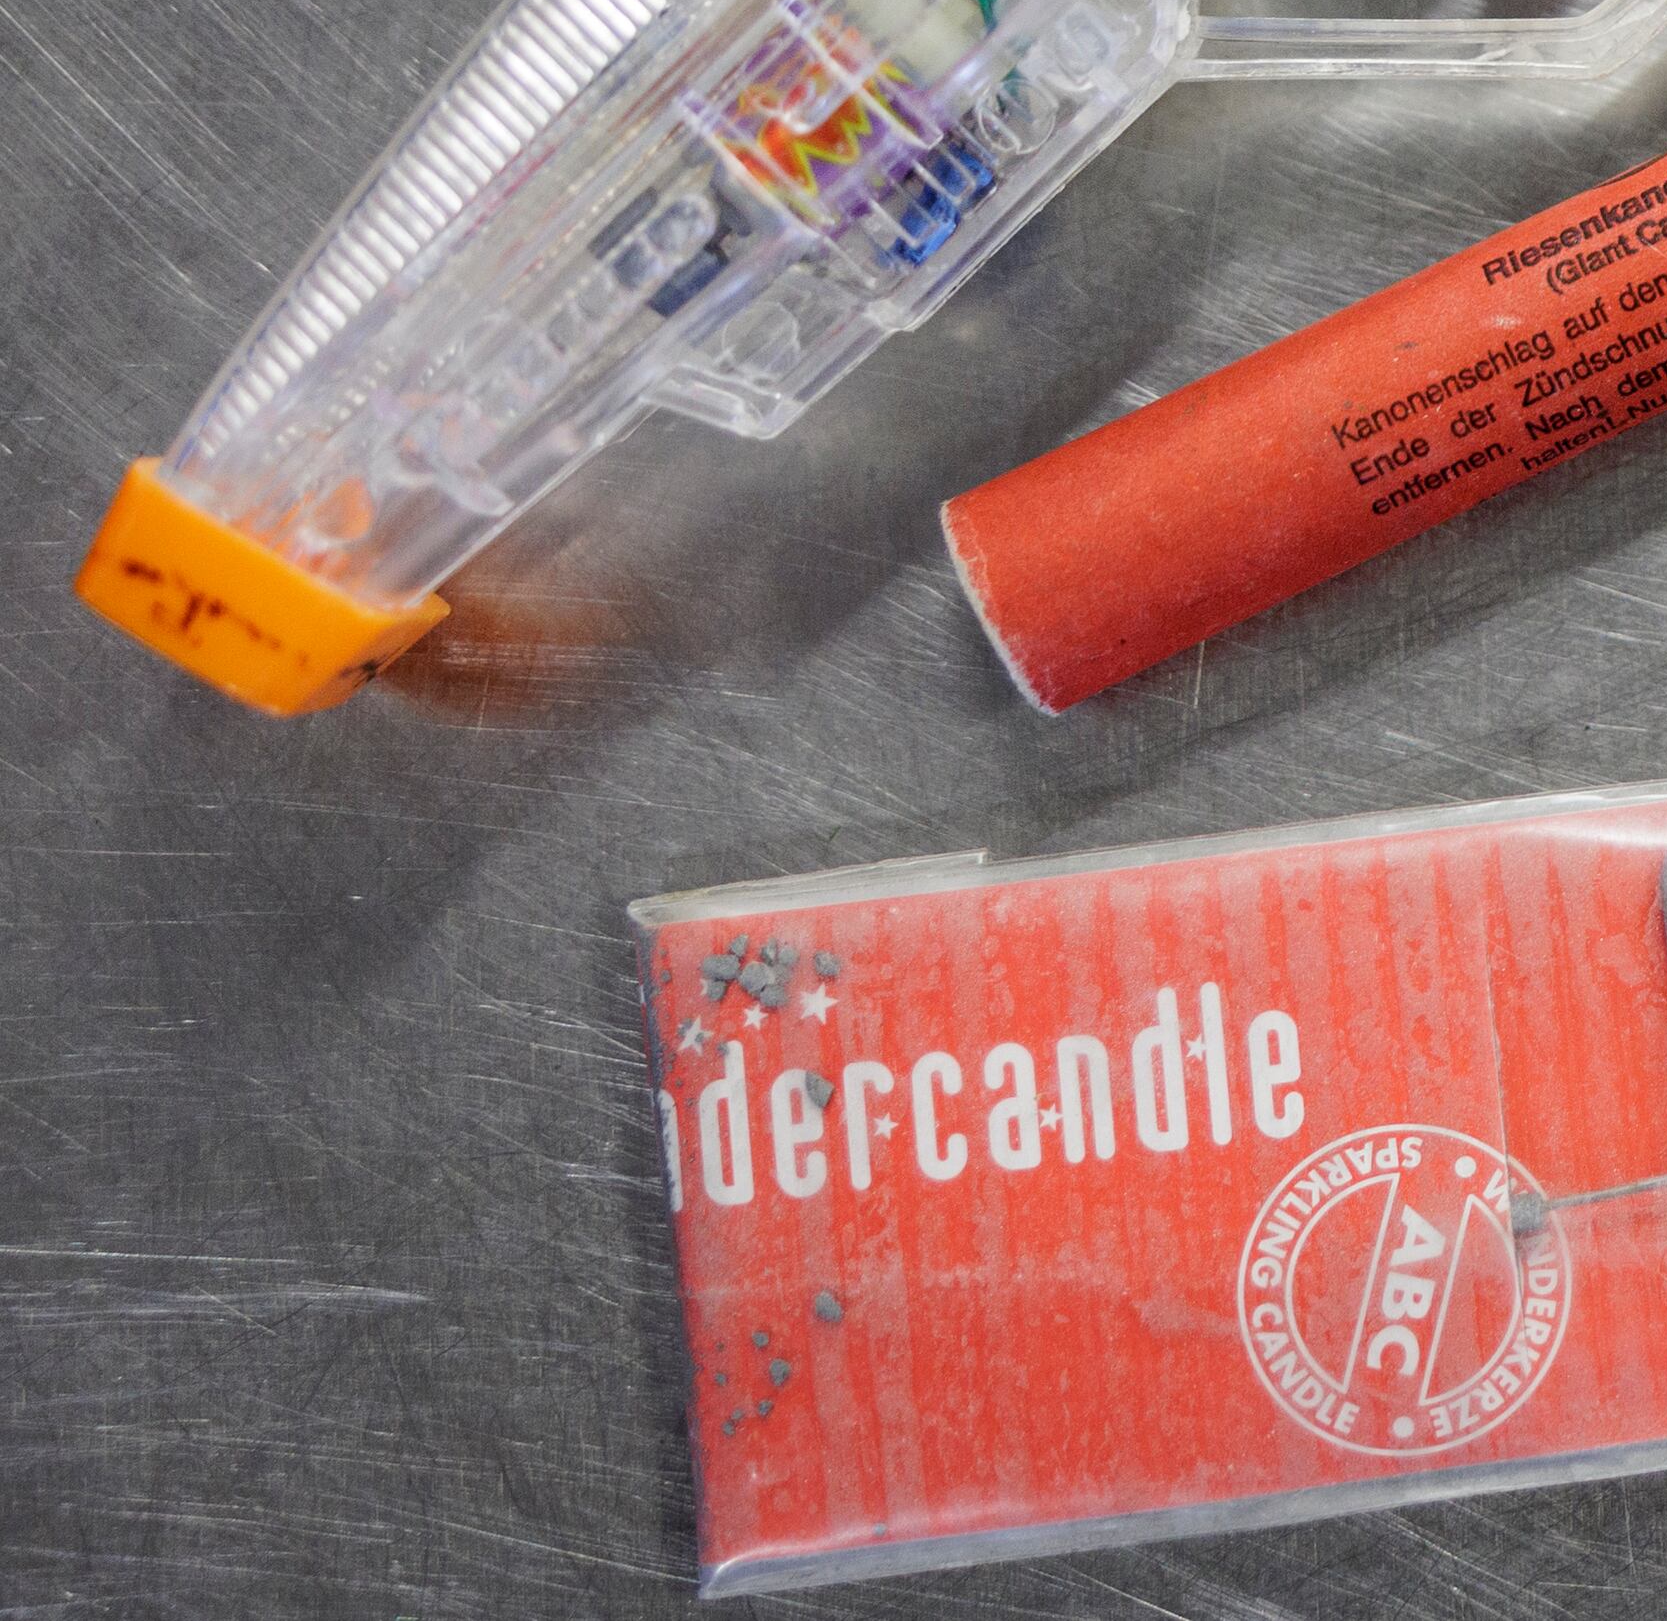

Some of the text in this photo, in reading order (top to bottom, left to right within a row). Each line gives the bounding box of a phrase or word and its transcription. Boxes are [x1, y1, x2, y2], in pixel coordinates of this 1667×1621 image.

[1330, 330, 1555, 450] Kanonenschlag
[1563, 297, 1610, 340] auf
[1351, 434, 1430, 486] Ende
[1450, 401, 1498, 438] der
[1371, 442, 1513, 516] entfernen.
[1524, 393, 1605, 442] Nach
[1250, 1136, 1424, 1434] SPARKLING CANDLE
[1366, 1204, 1447, 1377] ABC
[1430, 1168, 1559, 1438] WNDERKERZE
